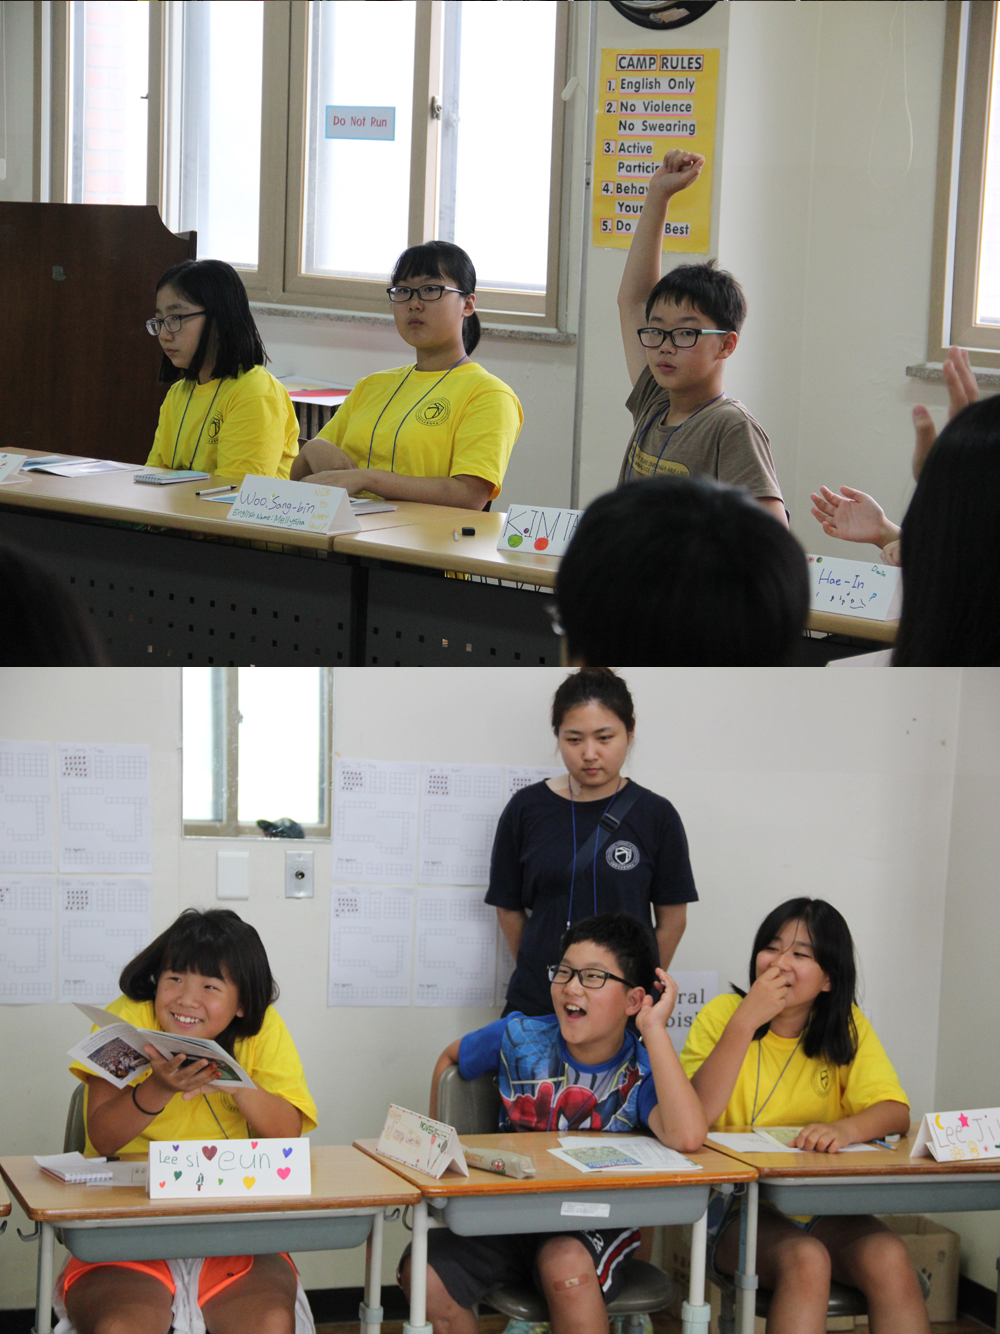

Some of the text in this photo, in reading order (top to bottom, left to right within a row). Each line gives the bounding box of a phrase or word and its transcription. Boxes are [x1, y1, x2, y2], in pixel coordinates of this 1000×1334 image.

[619, 56, 702, 70] CAMP RULES
[607, 78, 695, 93] 1. English Only
[606, 101, 692, 114] 2. No Violence
[333, 115, 387, 127] Do Not Run
[618, 120, 696, 136] No Swearing
[604, 142, 653, 154] 3. Active
[602, 183, 613, 194] 4.
[601, 220, 690, 235] 5. Do Best
[232, 509, 255, 518] English
[666, 1012, 698, 1027] ois
[931, 1122, 967, 1148] Lee
[159, 1150, 178, 1164] Lee
